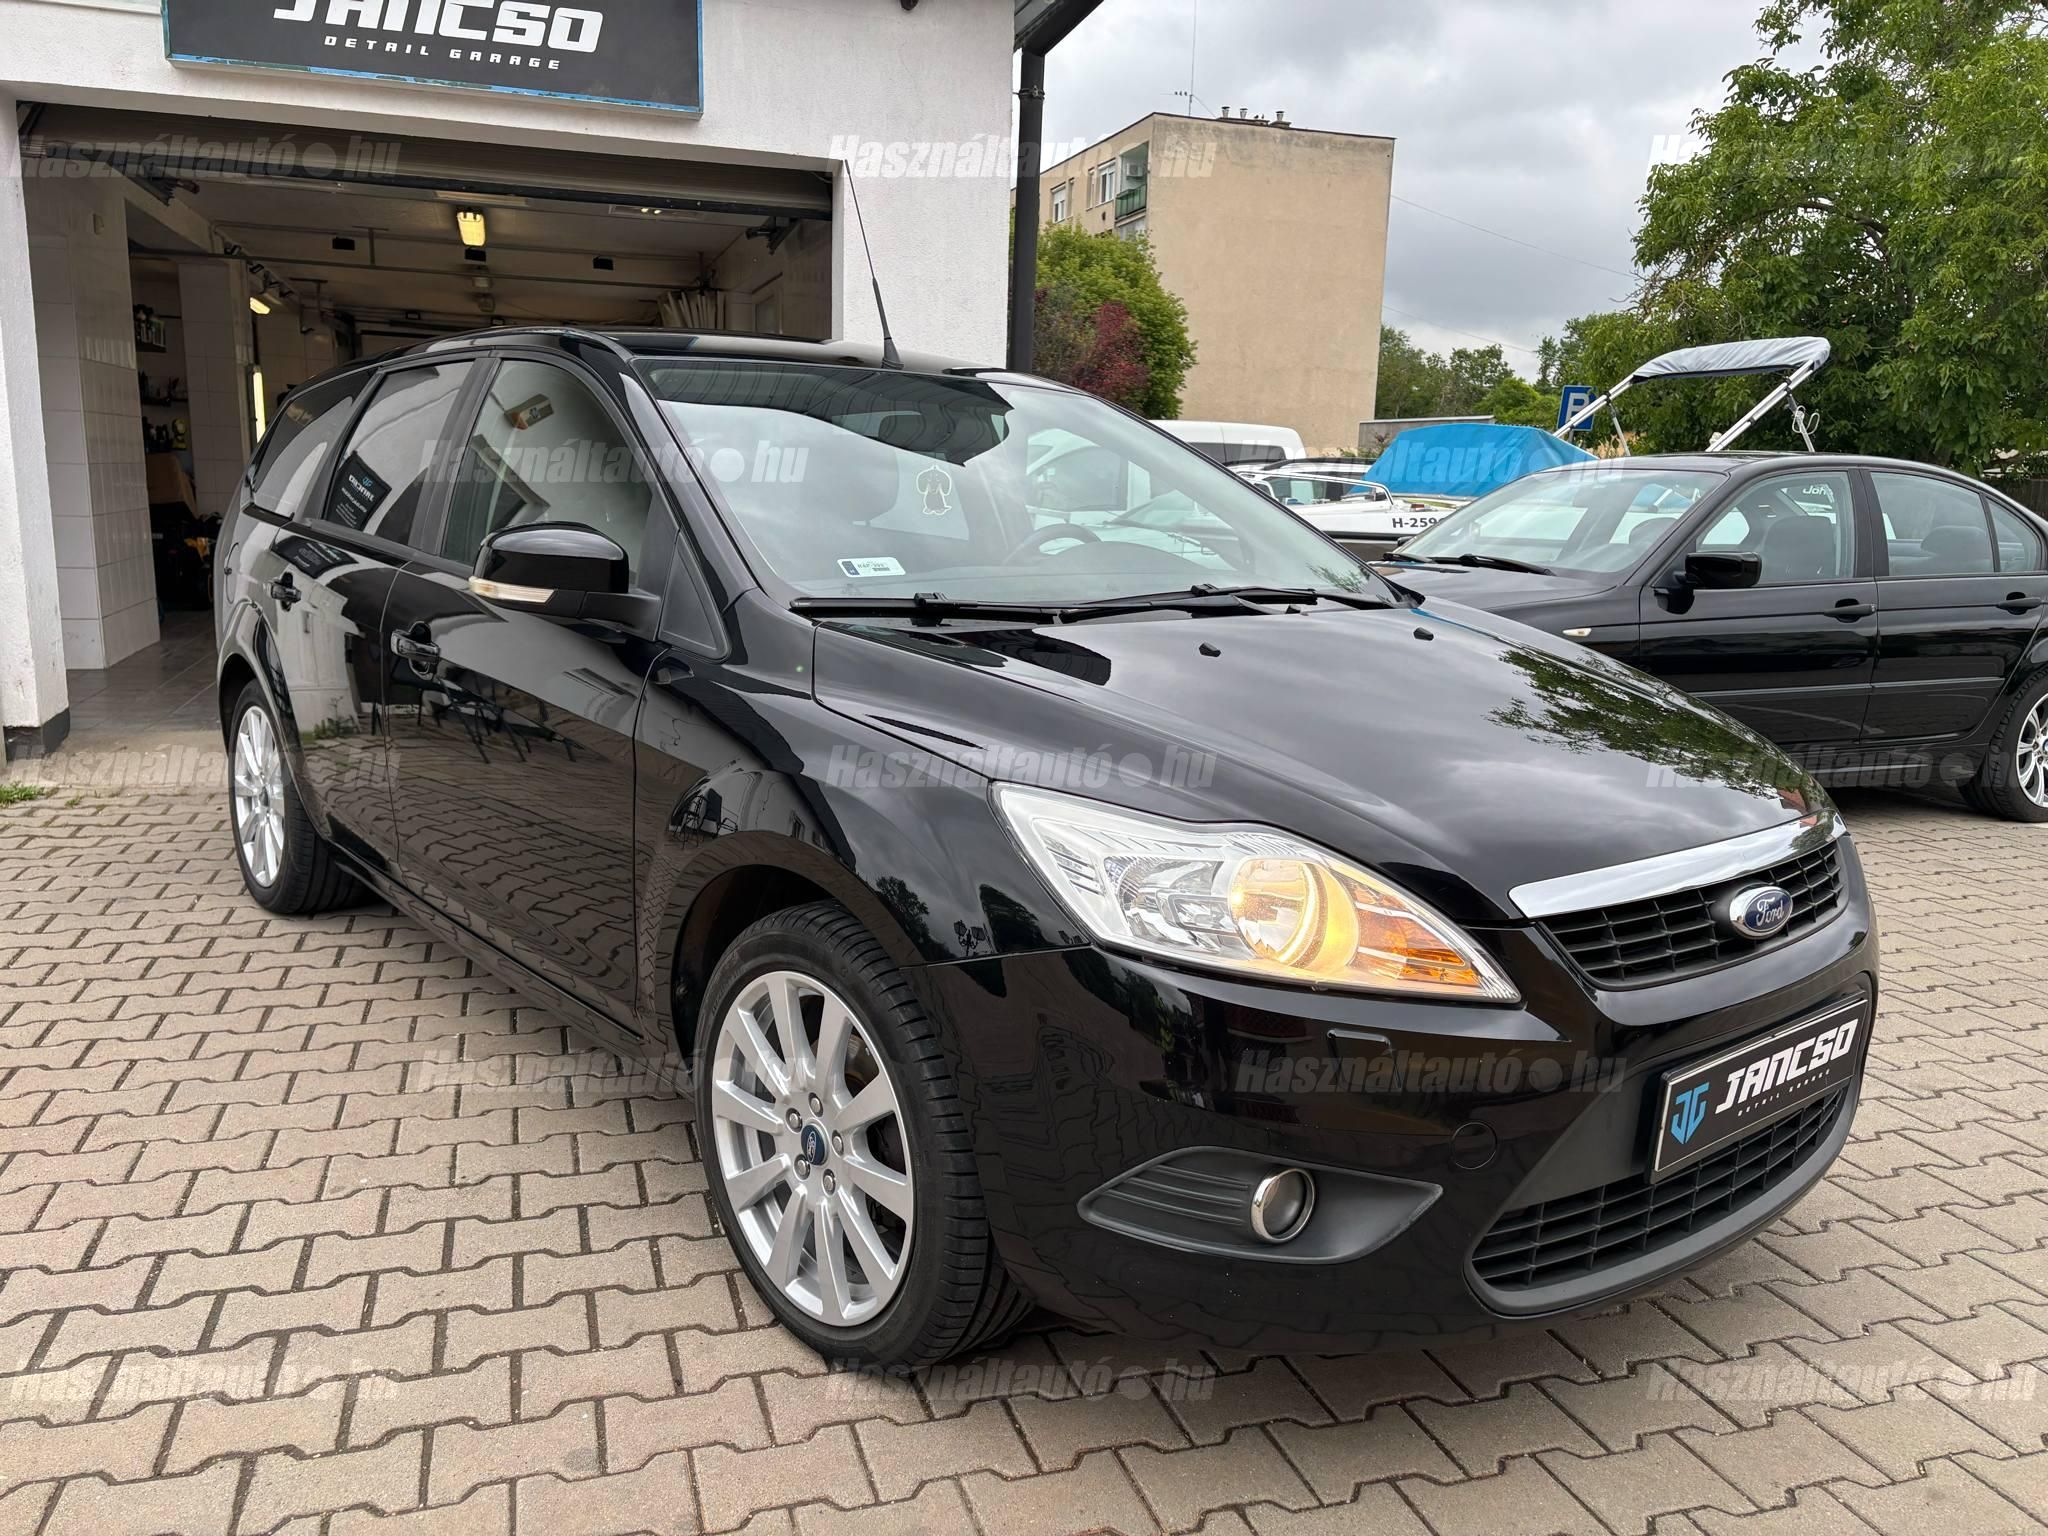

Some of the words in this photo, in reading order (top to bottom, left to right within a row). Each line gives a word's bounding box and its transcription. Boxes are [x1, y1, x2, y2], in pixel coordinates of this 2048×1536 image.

[325, 36, 428, 55] DETAIL
[449, 49, 560, 69] GARAGE
[1565, 393, 1590, 424] P
[1392, 517, 1445, 528] H-259
[1756, 896, 1785, 927] Ford
[1715, 1019, 1858, 1114] JANCSO
